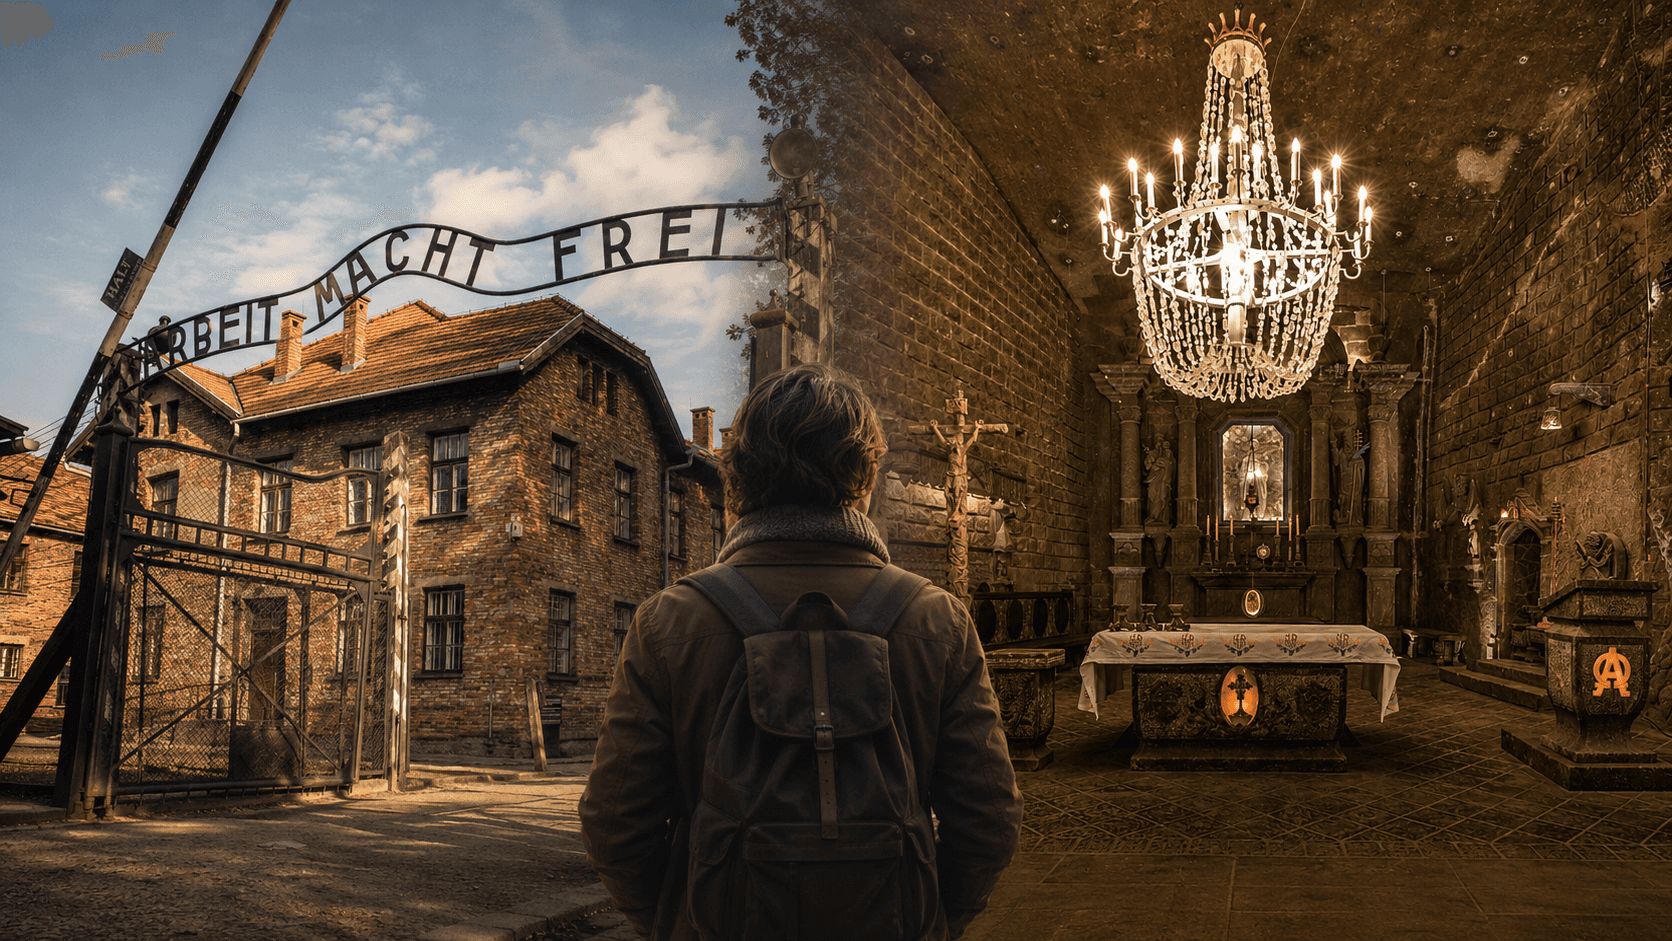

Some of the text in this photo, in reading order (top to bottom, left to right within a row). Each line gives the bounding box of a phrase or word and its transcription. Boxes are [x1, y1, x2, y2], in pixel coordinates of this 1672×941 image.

[142, 207, 726, 378] ARBEIT MACHT FREI
